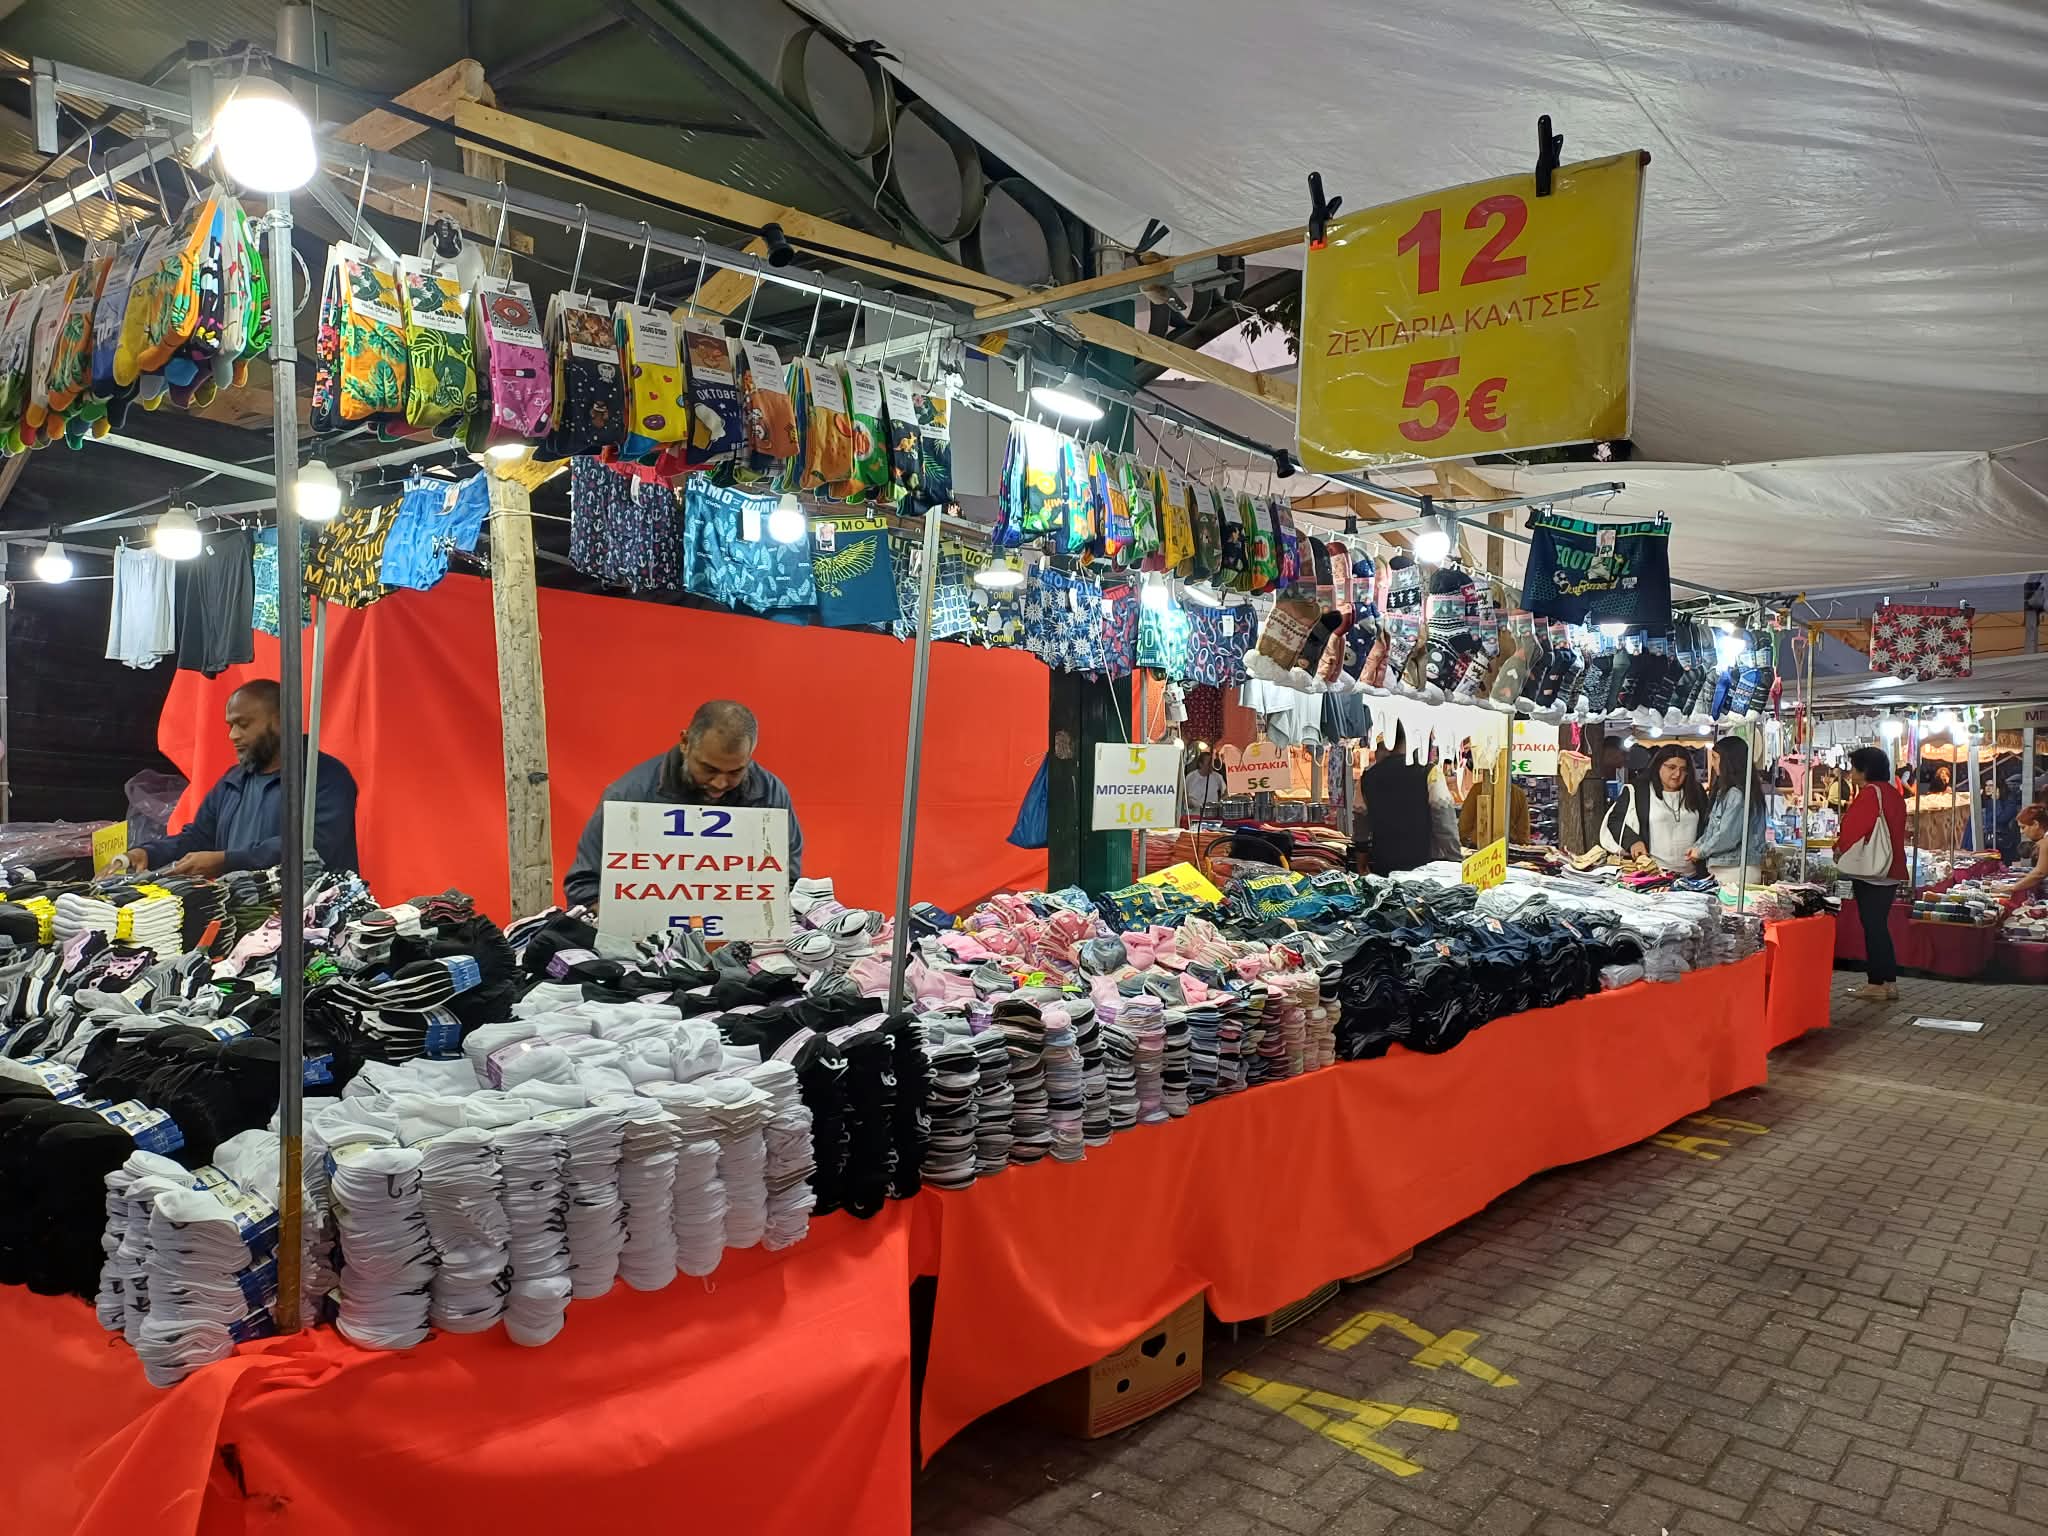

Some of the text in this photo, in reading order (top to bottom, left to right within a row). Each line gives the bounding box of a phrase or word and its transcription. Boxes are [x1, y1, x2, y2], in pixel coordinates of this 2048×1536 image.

[1397, 194, 1528, 295] 12
[1325, 283, 1602, 358] ΖΕΥΓΑΡΙΑ ΚΑΛΤΣΕΣ
[1398, 356, 1508, 443] 5€
[1128, 746, 1148, 776] 5
[1096, 784, 1175, 796] ΜΠΟΞΕΡΑΚΙΑ
[1247, 776, 1271, 790] 5€
[663, 808, 734, 838] 12
[1115, 801, 1154, 824] 10€
[606, 852, 783, 873] ΖΕΥΓΑΡΙΑ
[613, 882, 776, 901] ΚΑΛΤΣΕΣ
